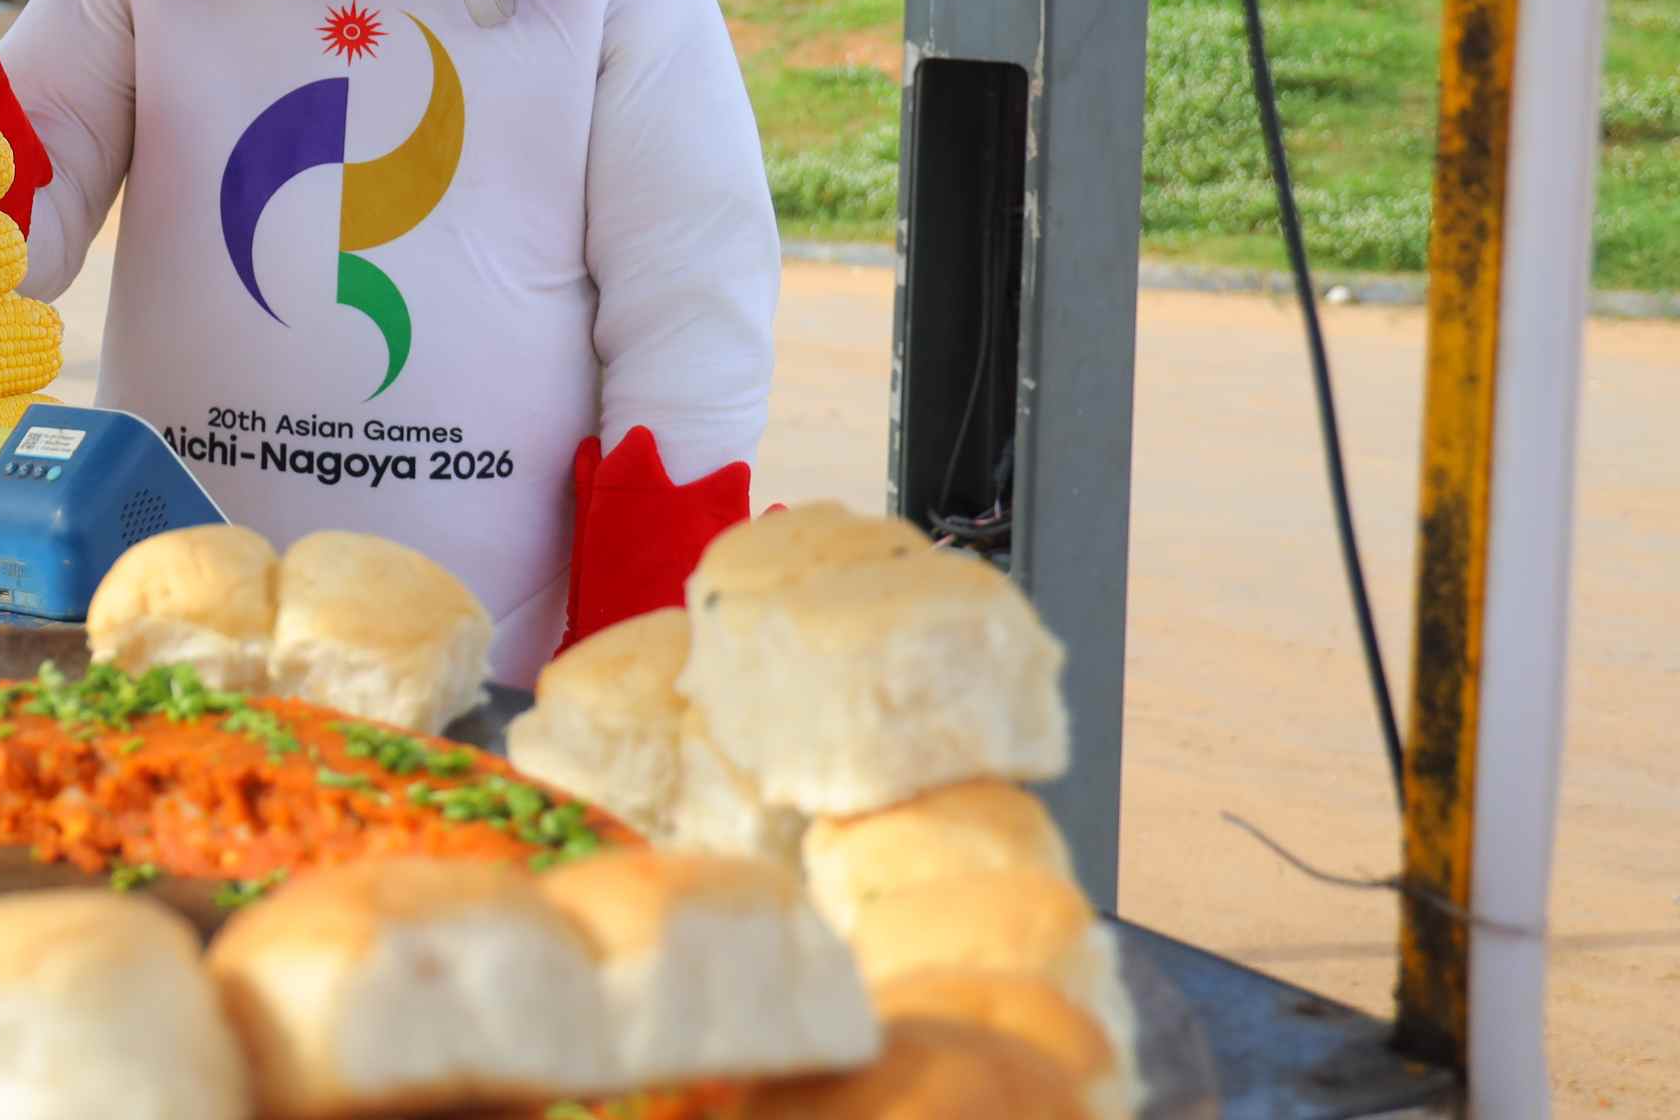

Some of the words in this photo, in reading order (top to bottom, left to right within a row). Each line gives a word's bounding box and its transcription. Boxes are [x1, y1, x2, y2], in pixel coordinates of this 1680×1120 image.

[207, 406, 267, 433] 20th
[275, 414, 354, 440] Asian
[363, 420, 463, 444] Games
[163, 425, 417, 487] Aichi-Nagoya
[428, 449, 514, 480] 2026
